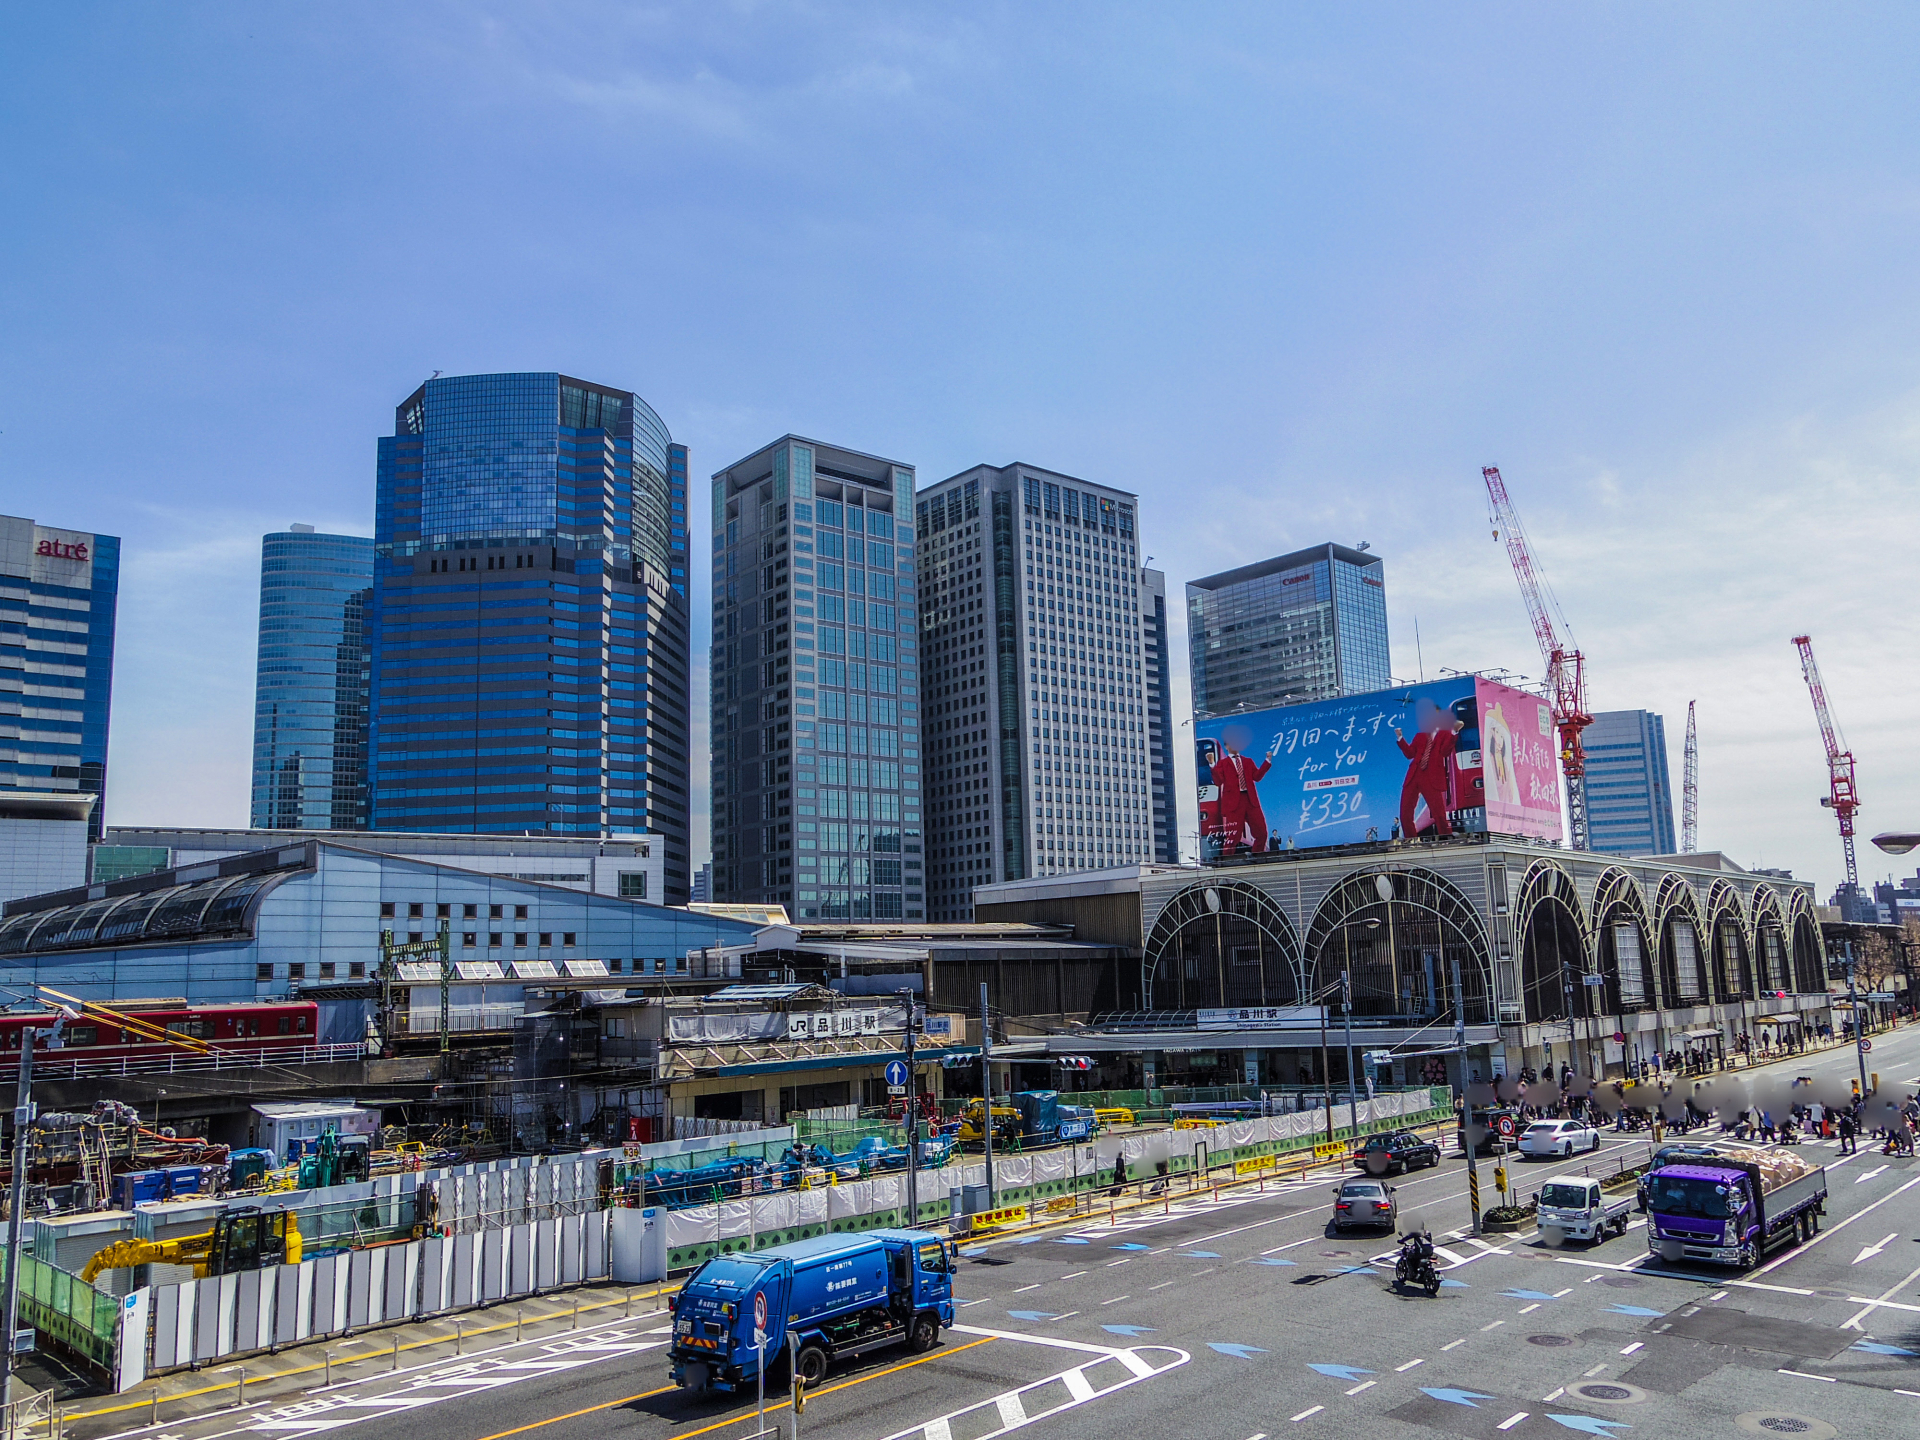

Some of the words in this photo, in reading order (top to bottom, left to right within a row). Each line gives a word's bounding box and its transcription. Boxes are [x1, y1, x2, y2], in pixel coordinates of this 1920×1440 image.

[38, 539, 88, 560] atré
[1282, 574, 1310, 586] Canon
[1269, 711, 1405, 756] 羽田へまっすぐ
[1298, 757, 1328, 780] for
[1299, 791, 1363, 830] ¥330
[1445, 808, 1480, 820] KEIKYU
[1239, 1008, 1278, 1020] 品川駅
[790, 1020, 807, 1033] JR
